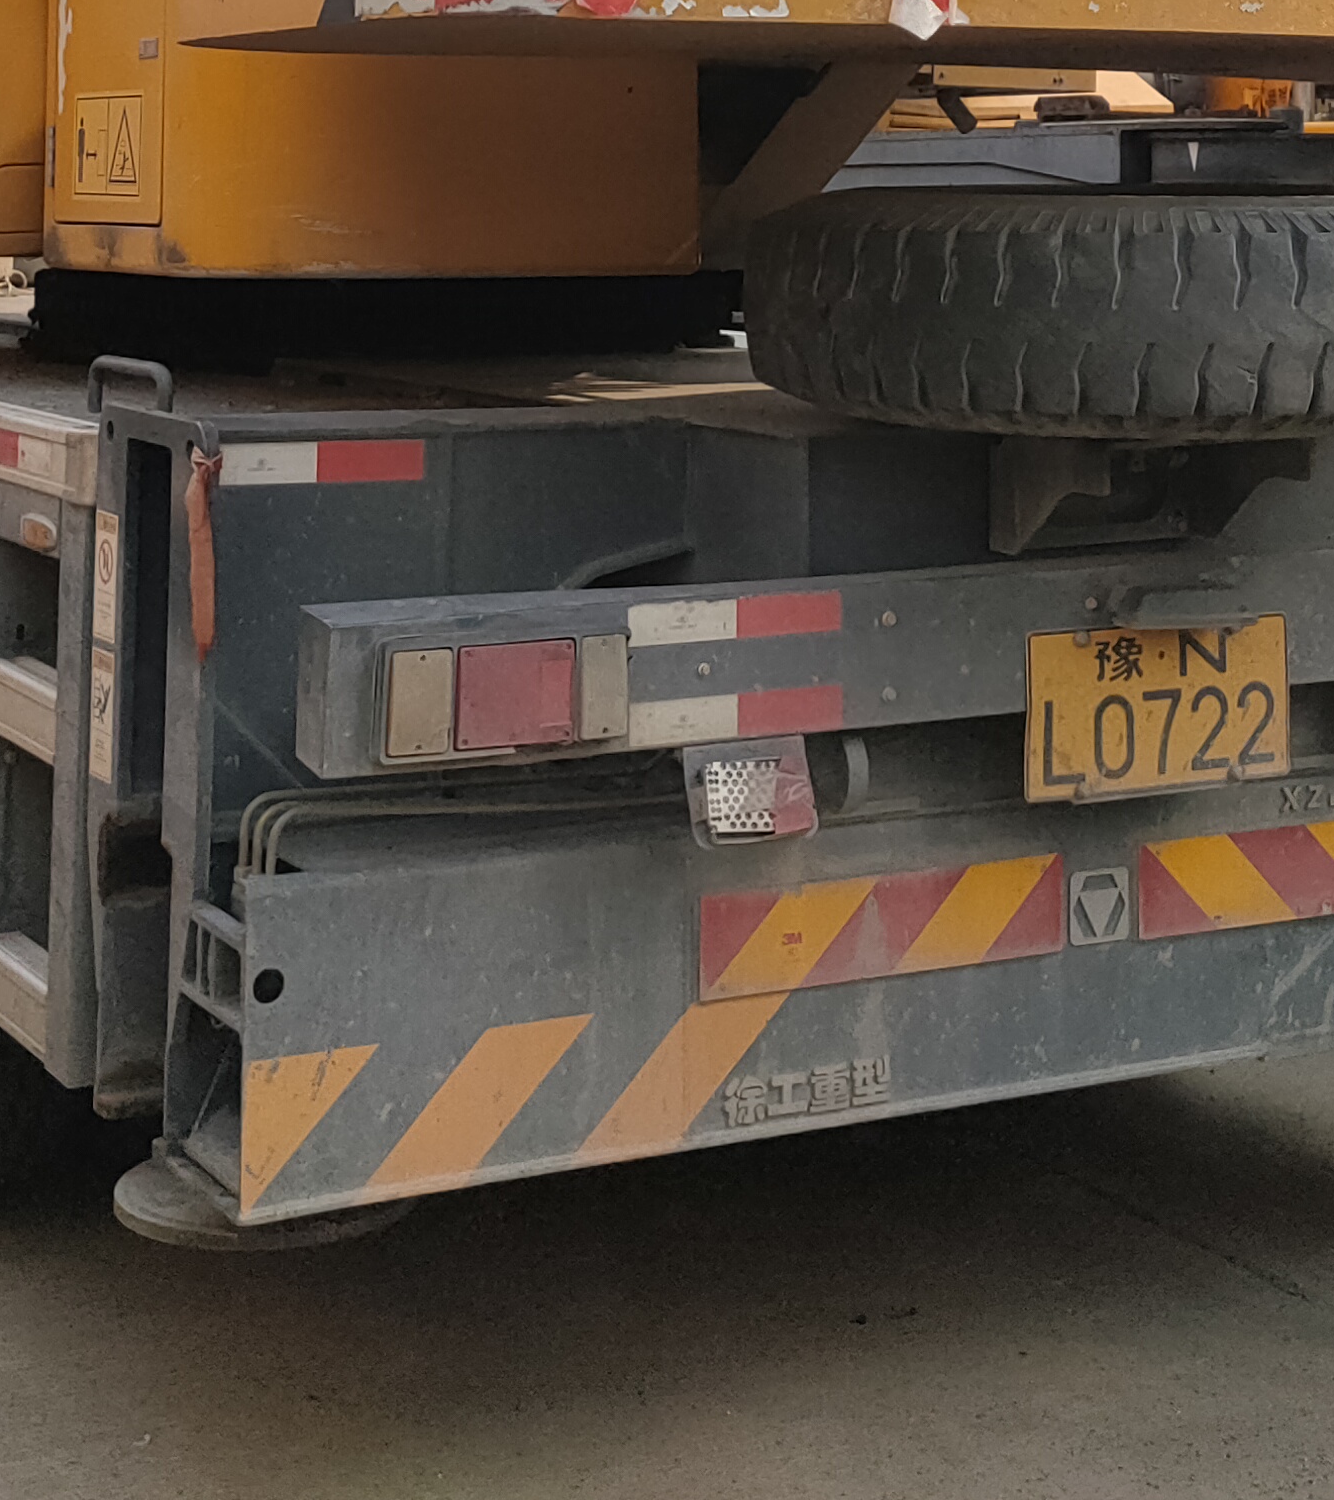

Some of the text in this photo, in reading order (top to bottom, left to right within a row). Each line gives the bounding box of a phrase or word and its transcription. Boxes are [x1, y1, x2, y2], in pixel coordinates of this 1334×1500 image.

[1042, 680, 1275, 787] L0722
[722, 1053, 892, 1128] 徐工重型
